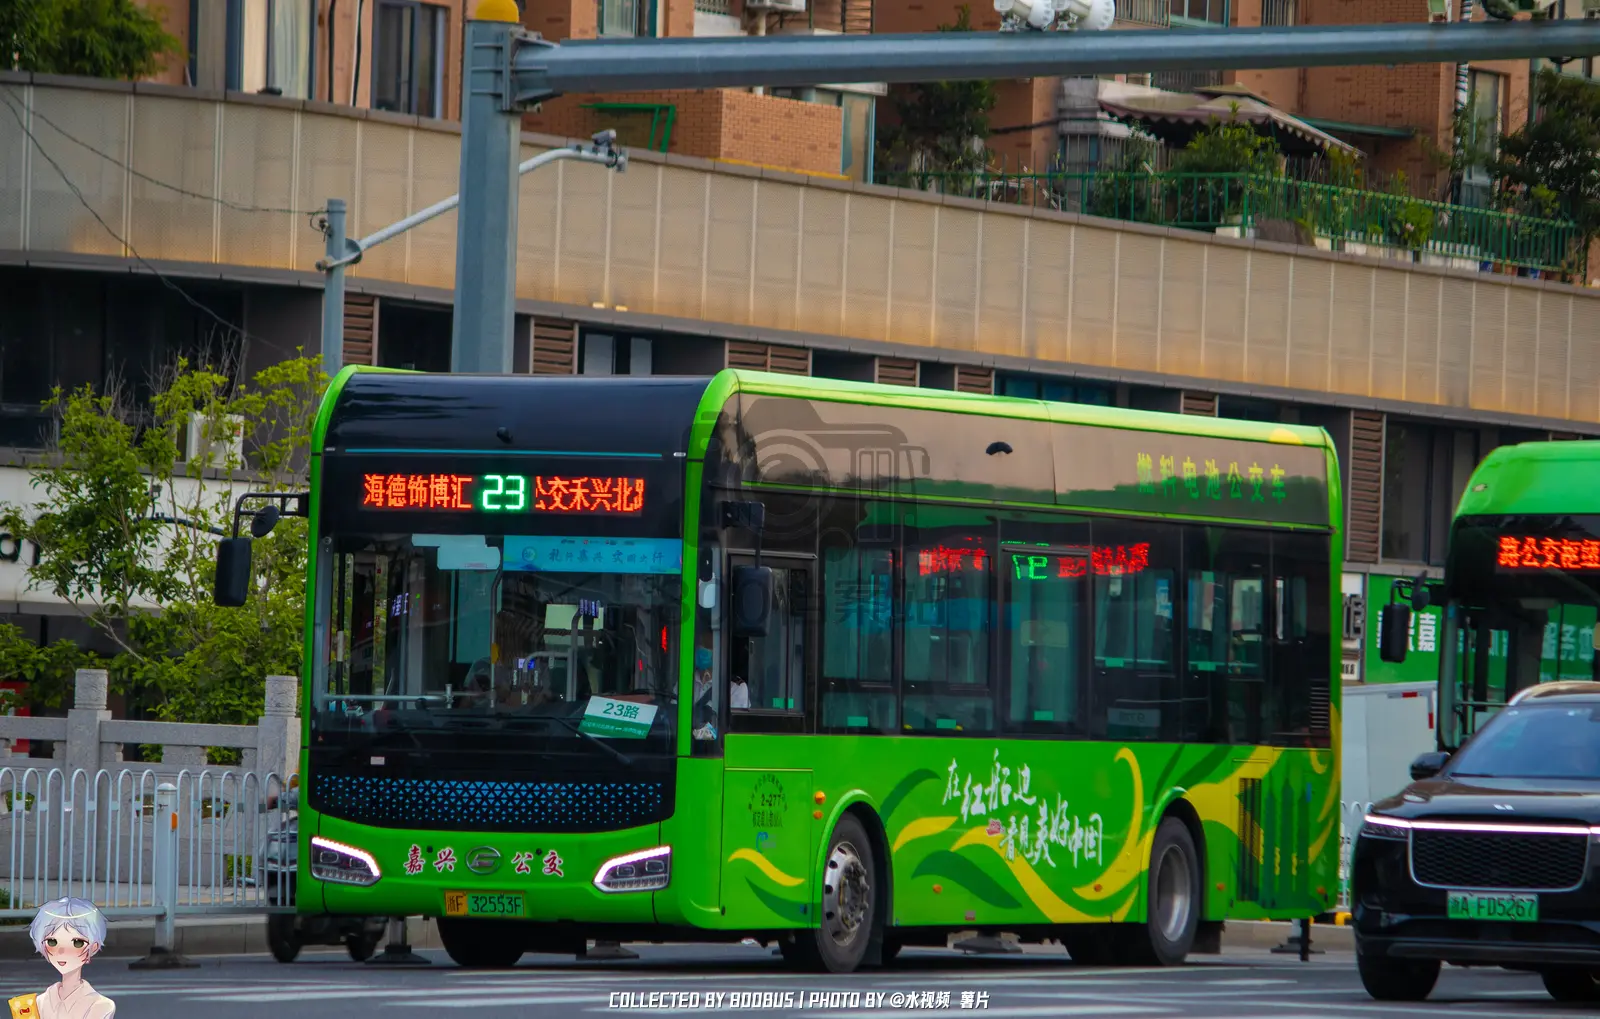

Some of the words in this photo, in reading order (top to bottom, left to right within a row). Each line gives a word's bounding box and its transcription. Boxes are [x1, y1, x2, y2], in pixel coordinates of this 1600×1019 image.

[483, 475, 526, 509] 23
[1137, 452, 1287, 504] 燃料电池公交车
[603, 702, 640, 719] 23路
